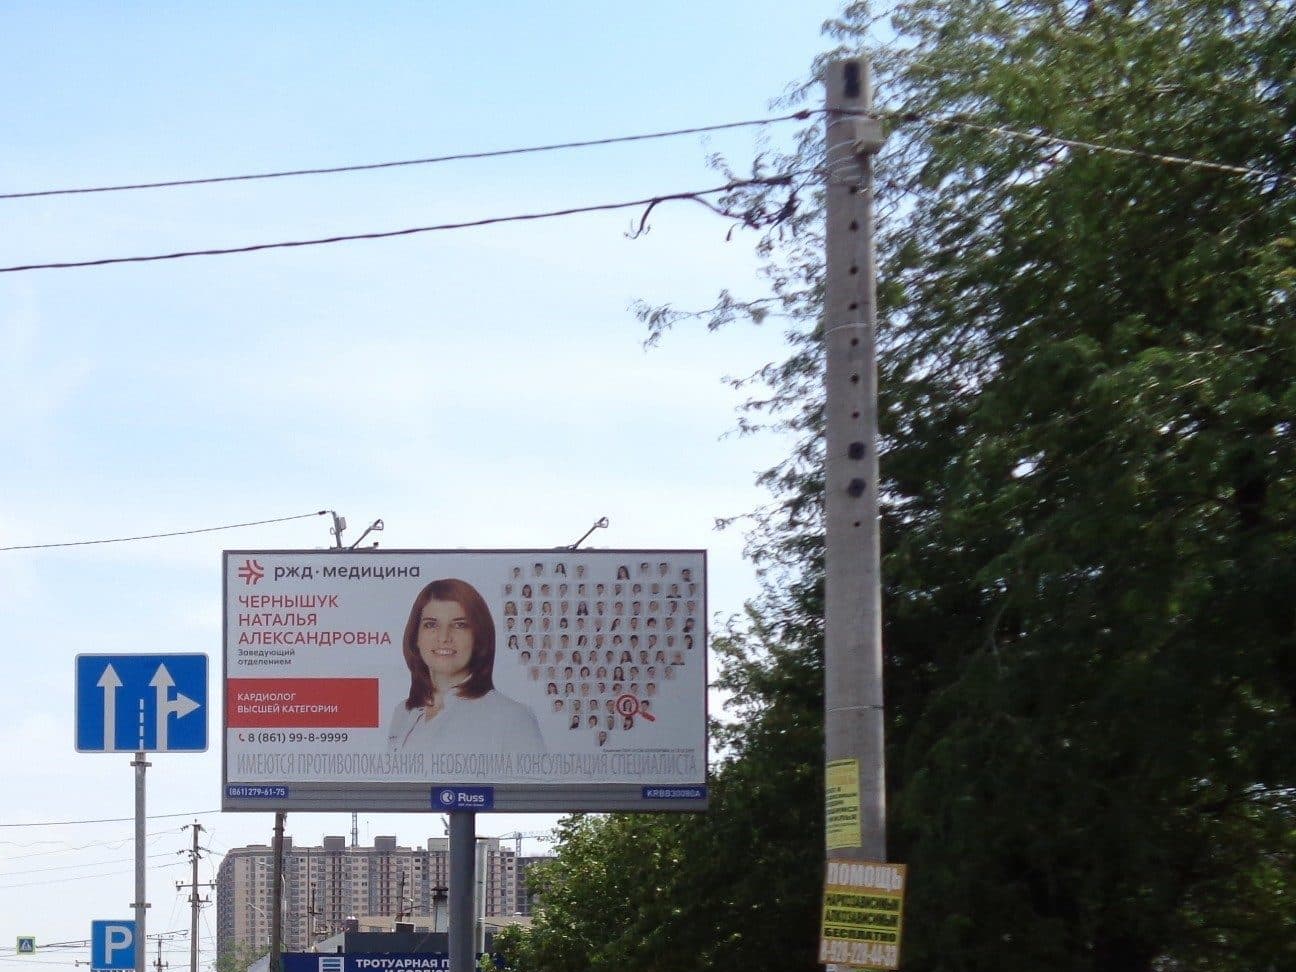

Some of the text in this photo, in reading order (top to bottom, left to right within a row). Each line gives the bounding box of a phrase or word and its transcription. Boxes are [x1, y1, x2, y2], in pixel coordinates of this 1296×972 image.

[238, 595, 339, 608] ЧЕРНЫШУК
[238, 613, 317, 627] НАТАЛЬЯ
[238, 631, 392, 646] АЛЕКСАНДРОВНА
[237, 648, 296, 658] Заведующий
[237, 658, 292, 666] отделением
[237, 693, 296, 702] КАРДИОЛОГ
[237, 704, 338, 714] ВЫСШЕЙ КАТЕГОРИИ
[248, 733, 349, 744] 8 (861) 99-8-9999
[237, 752, 296, 775] ИМЕЮТСЯ
[432, 752, 512, 777] НЕОБХОДИМА
[517, 752, 608, 777] КОНСУЛЬТАЦИЯ
[458, 793, 485, 802] Russ
[826, 863, 903, 891] ПОМОЩЬ
[824, 928, 896, 942] БЕСПЛАТНО
[104, 925, 133, 965] P
[356, 958, 438, 969] ТРОТУАРНАЯ
